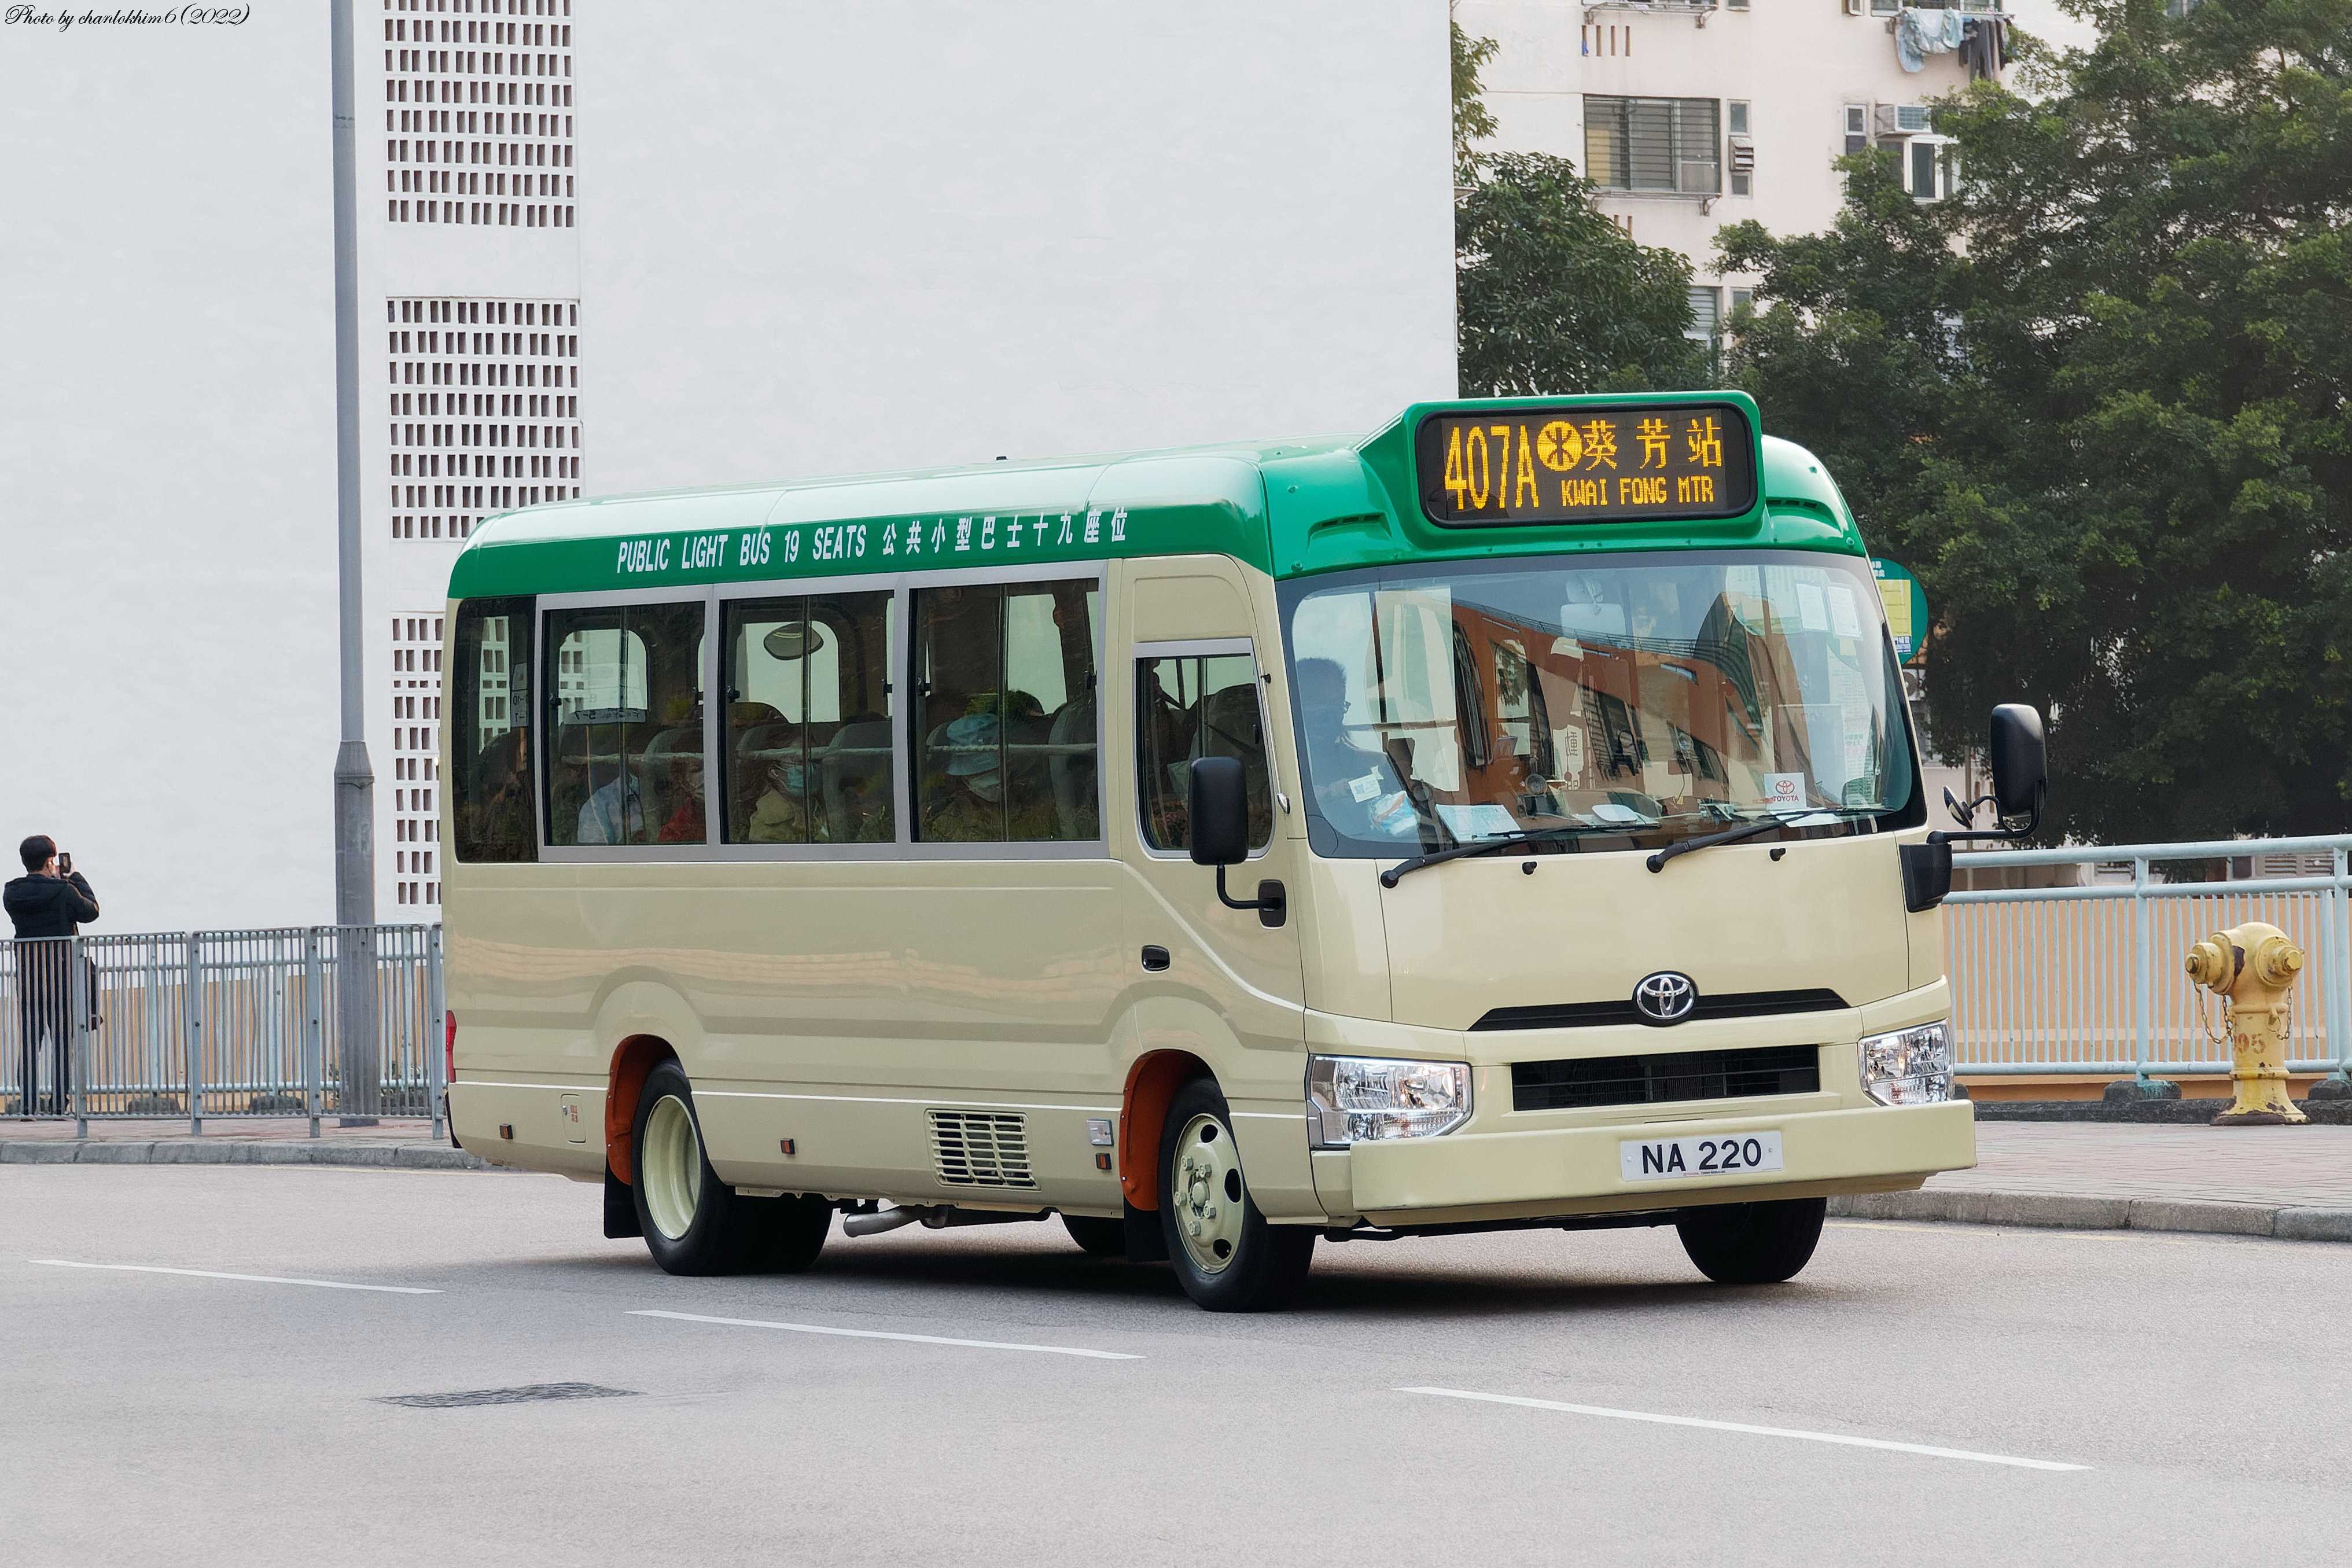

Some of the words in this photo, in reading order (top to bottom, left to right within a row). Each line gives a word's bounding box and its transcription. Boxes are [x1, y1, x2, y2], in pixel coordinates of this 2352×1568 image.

[1445, 425, 1539, 510] 407A
[1581, 417, 1722, 470] 葵芳站
[1562, 479, 1607, 507] KWAI
[1619, 477, 1666, 505] FONG
[1678, 475, 1713, 503] MTR
[617, 538, 670, 573] PUBLIC
[682, 534, 728, 569] LIGHT
[740, 532, 771, 566] BUS
[784, 530, 800, 563] 19
[812, 524, 867, 560] SEATS
[882, 506, 1128, 555] 公共小型巴士十九座位
[1642, 1143, 1686, 1174] NA
[1699, 1138, 1761, 1170] 220
